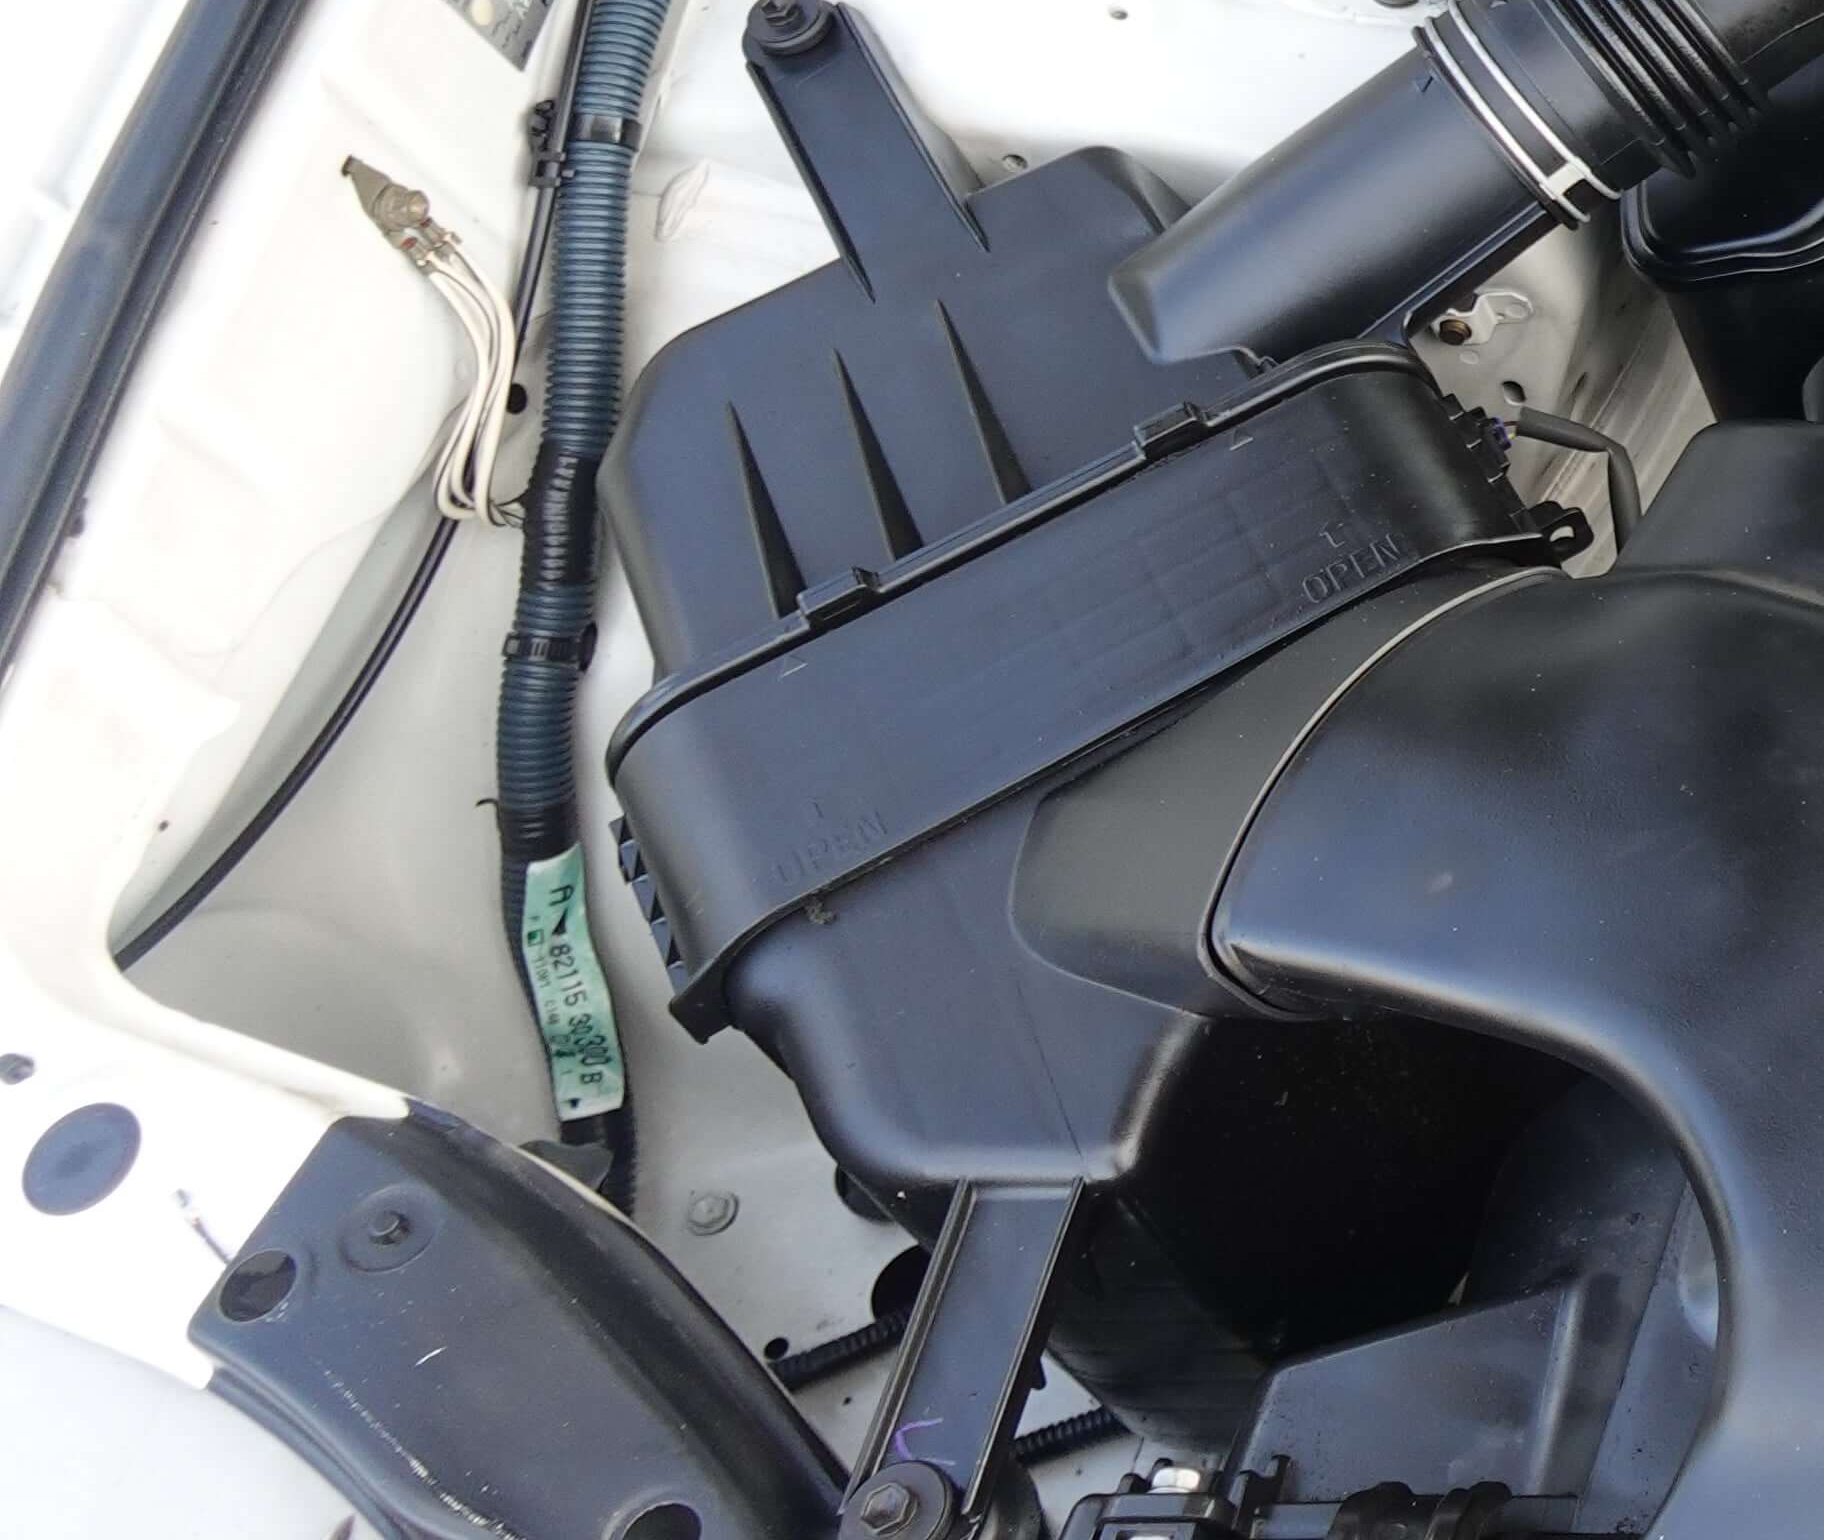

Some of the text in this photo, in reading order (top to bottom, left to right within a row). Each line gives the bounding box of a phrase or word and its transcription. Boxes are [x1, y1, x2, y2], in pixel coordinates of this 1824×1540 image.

[1302, 532, 1402, 605] OPEN
[547, 883, 576, 908] A
[549, 942, 589, 1007] 82115
